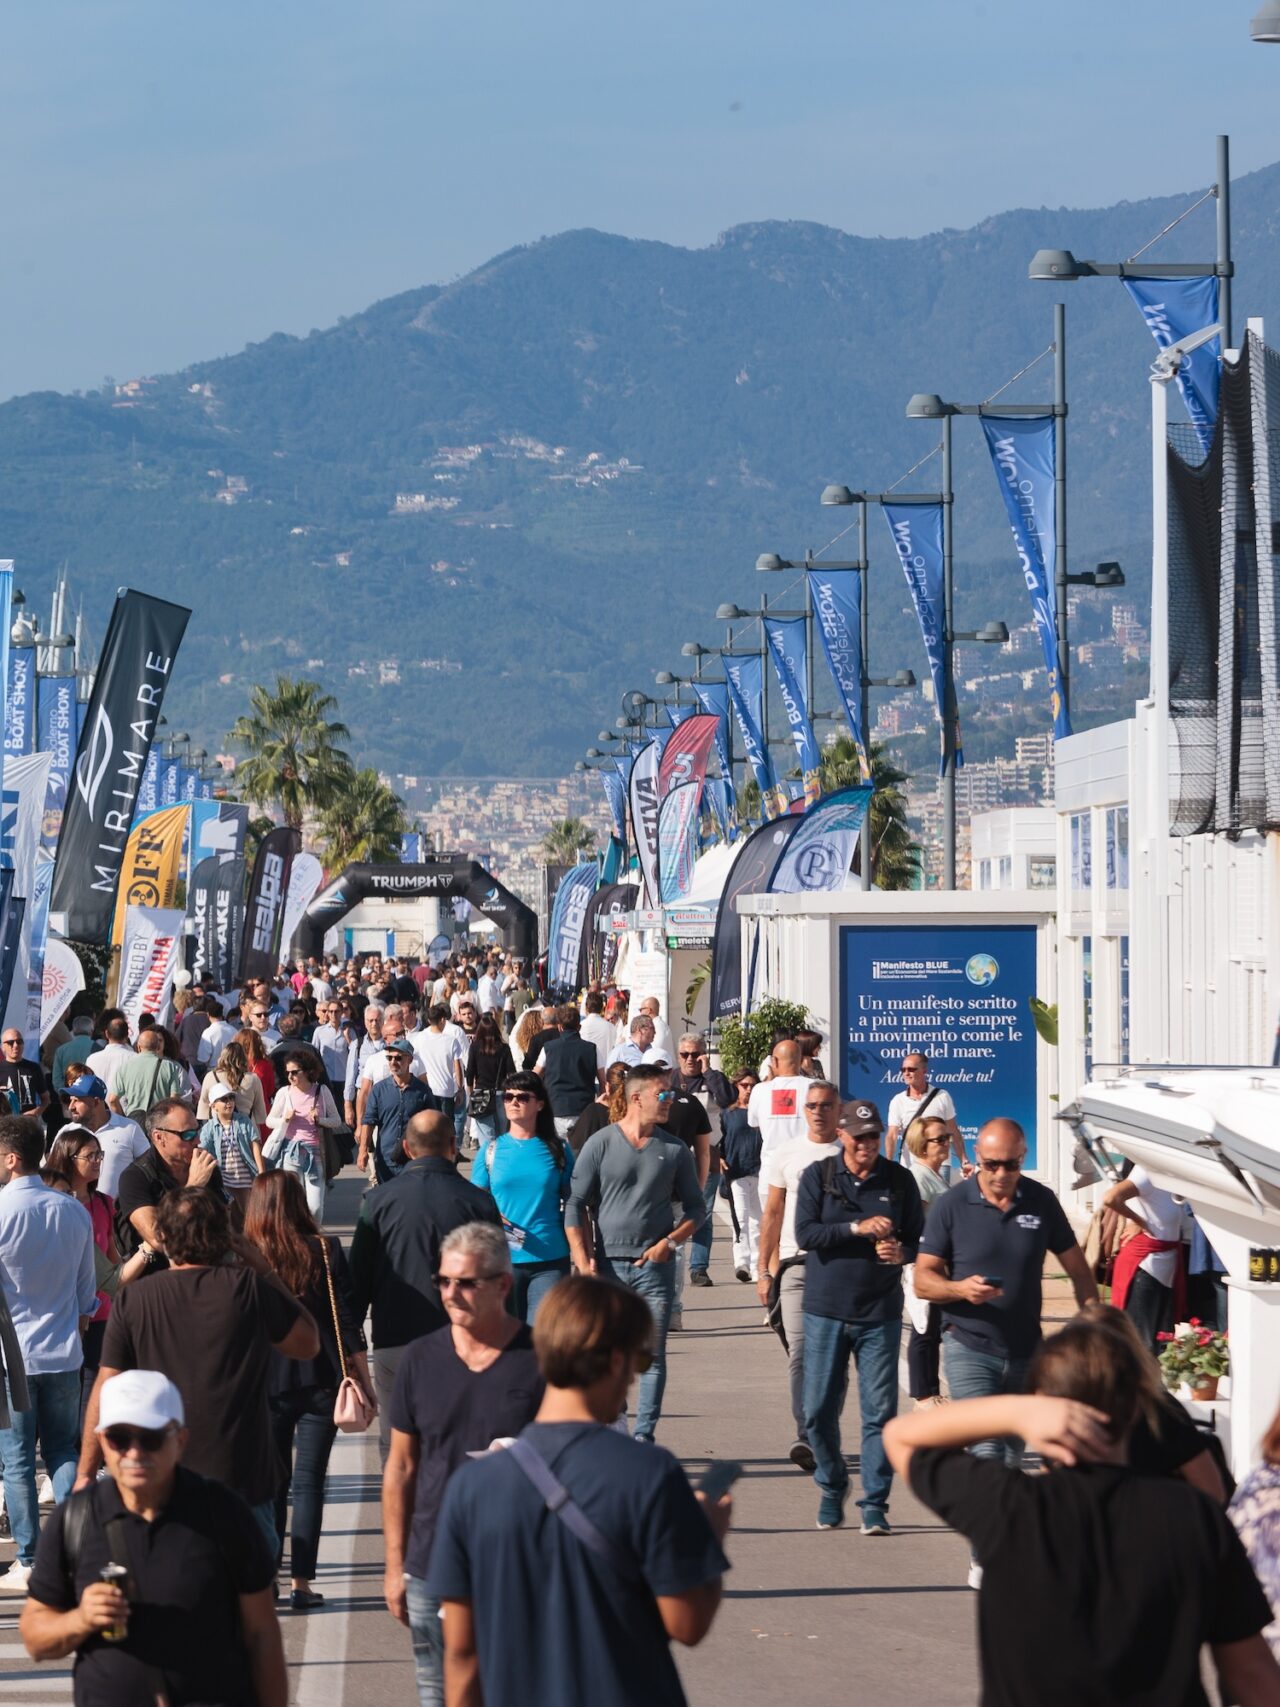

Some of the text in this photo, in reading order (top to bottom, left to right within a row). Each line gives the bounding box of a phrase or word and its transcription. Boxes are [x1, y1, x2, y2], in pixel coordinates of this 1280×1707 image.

[12, 659, 27, 749] BOAT SHOW
[57, 687, 71, 769] BOAT SHOW
[90, 650, 171, 893] MIRIMARE
[371, 875, 437, 889] TRIUMPH
[252, 852, 284, 953] salpa
[556, 883, 595, 987] salpa
[123, 934, 148, 1017] POWERED BY
[141, 936, 174, 1014] YAMAHA
[873, 961, 949, 979] il Manifesto BLUE
[53, 986, 72, 1012] nautica
[720, 997, 741, 1010] SERV
[858, 994, 1017, 1010] Un manifesto scritto
[858, 1011, 1017, 1030] a più mani e sempre
[849, 1027, 1023, 1042] in movimento come le
[924, 1043, 948, 1058] del
[953, 1047, 996, 1058] mare.
[935, 1069, 975, 1083] anche
[976, 1069, 995, 1083] tu!
